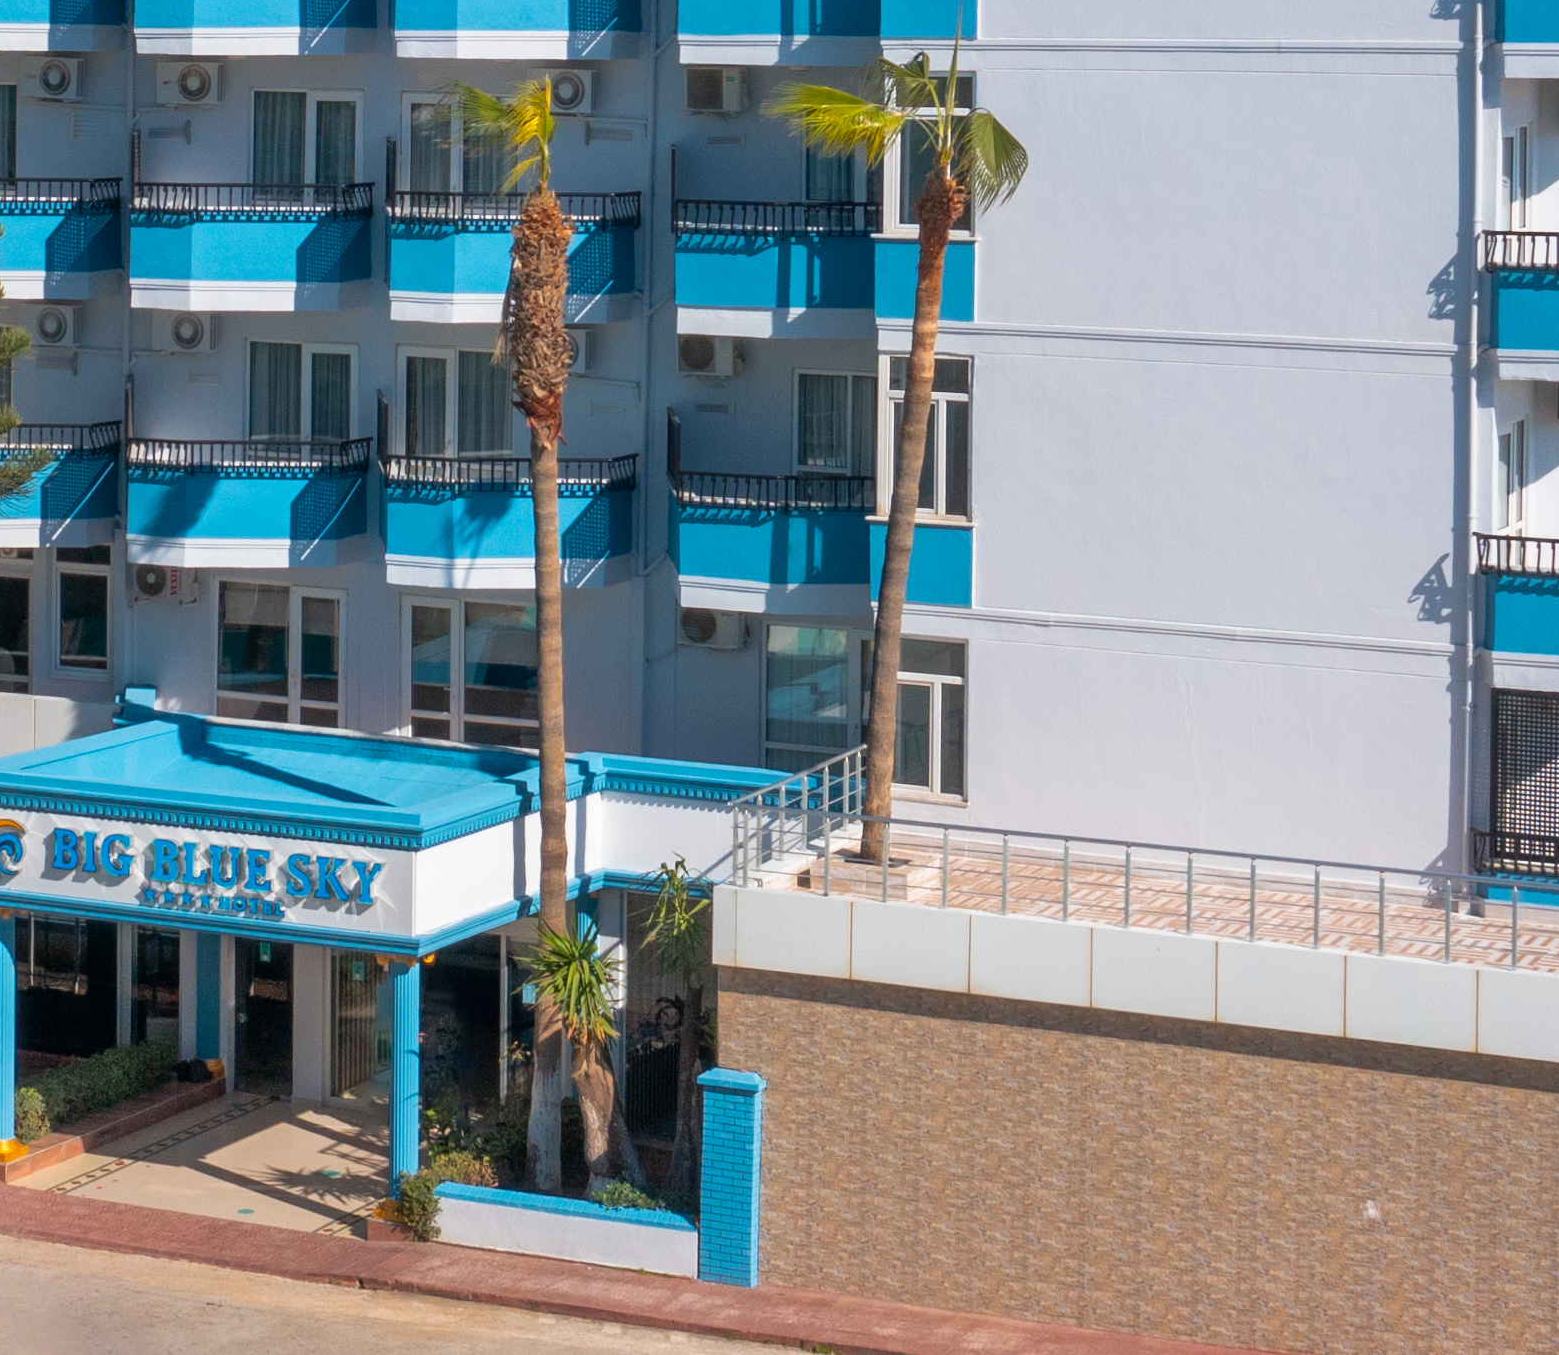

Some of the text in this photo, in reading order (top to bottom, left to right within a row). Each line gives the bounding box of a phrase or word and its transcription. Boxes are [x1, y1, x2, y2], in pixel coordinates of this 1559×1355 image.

[52, 827, 383, 905] BIG BLUE SKY
[218, 895, 285, 917] HOTEL
